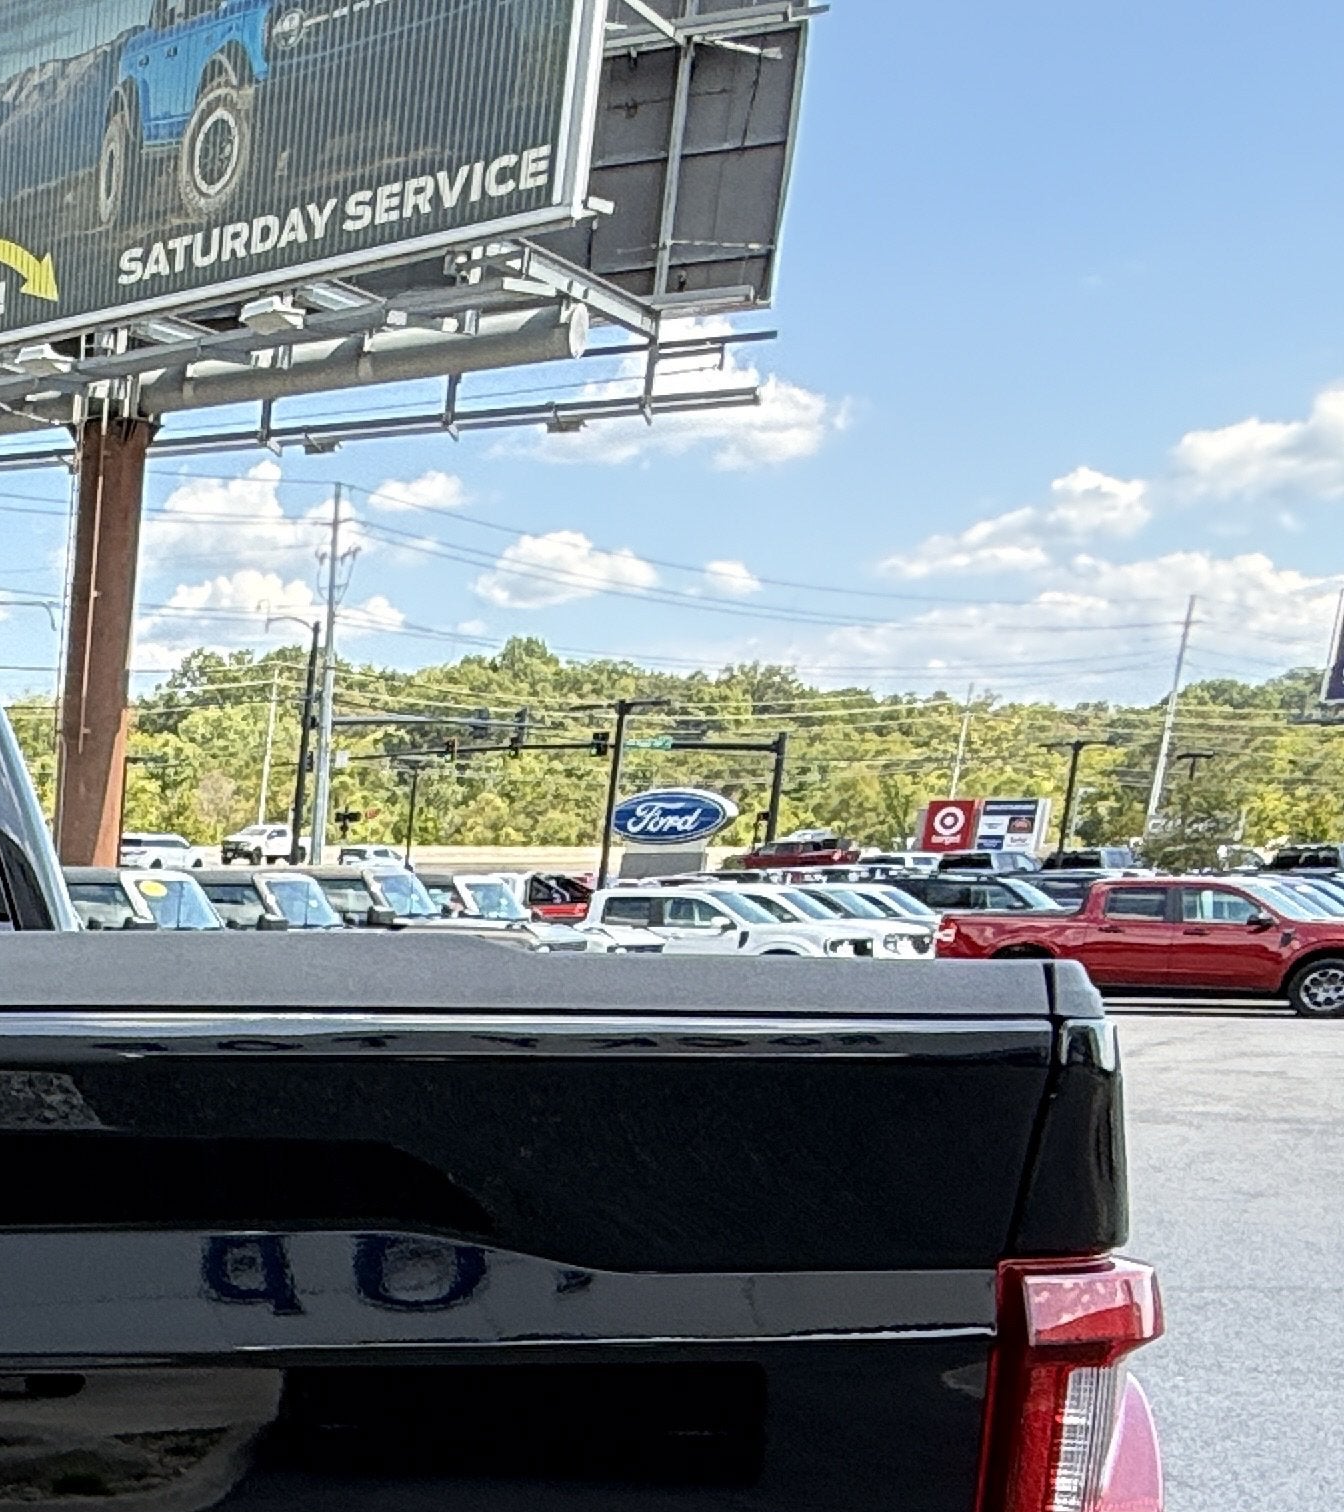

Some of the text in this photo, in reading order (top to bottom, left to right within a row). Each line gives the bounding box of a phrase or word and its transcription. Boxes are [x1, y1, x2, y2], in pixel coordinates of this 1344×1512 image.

[118, 144, 551, 285] SATURDAY SERVICE
[626, 802, 703, 833] Ford
